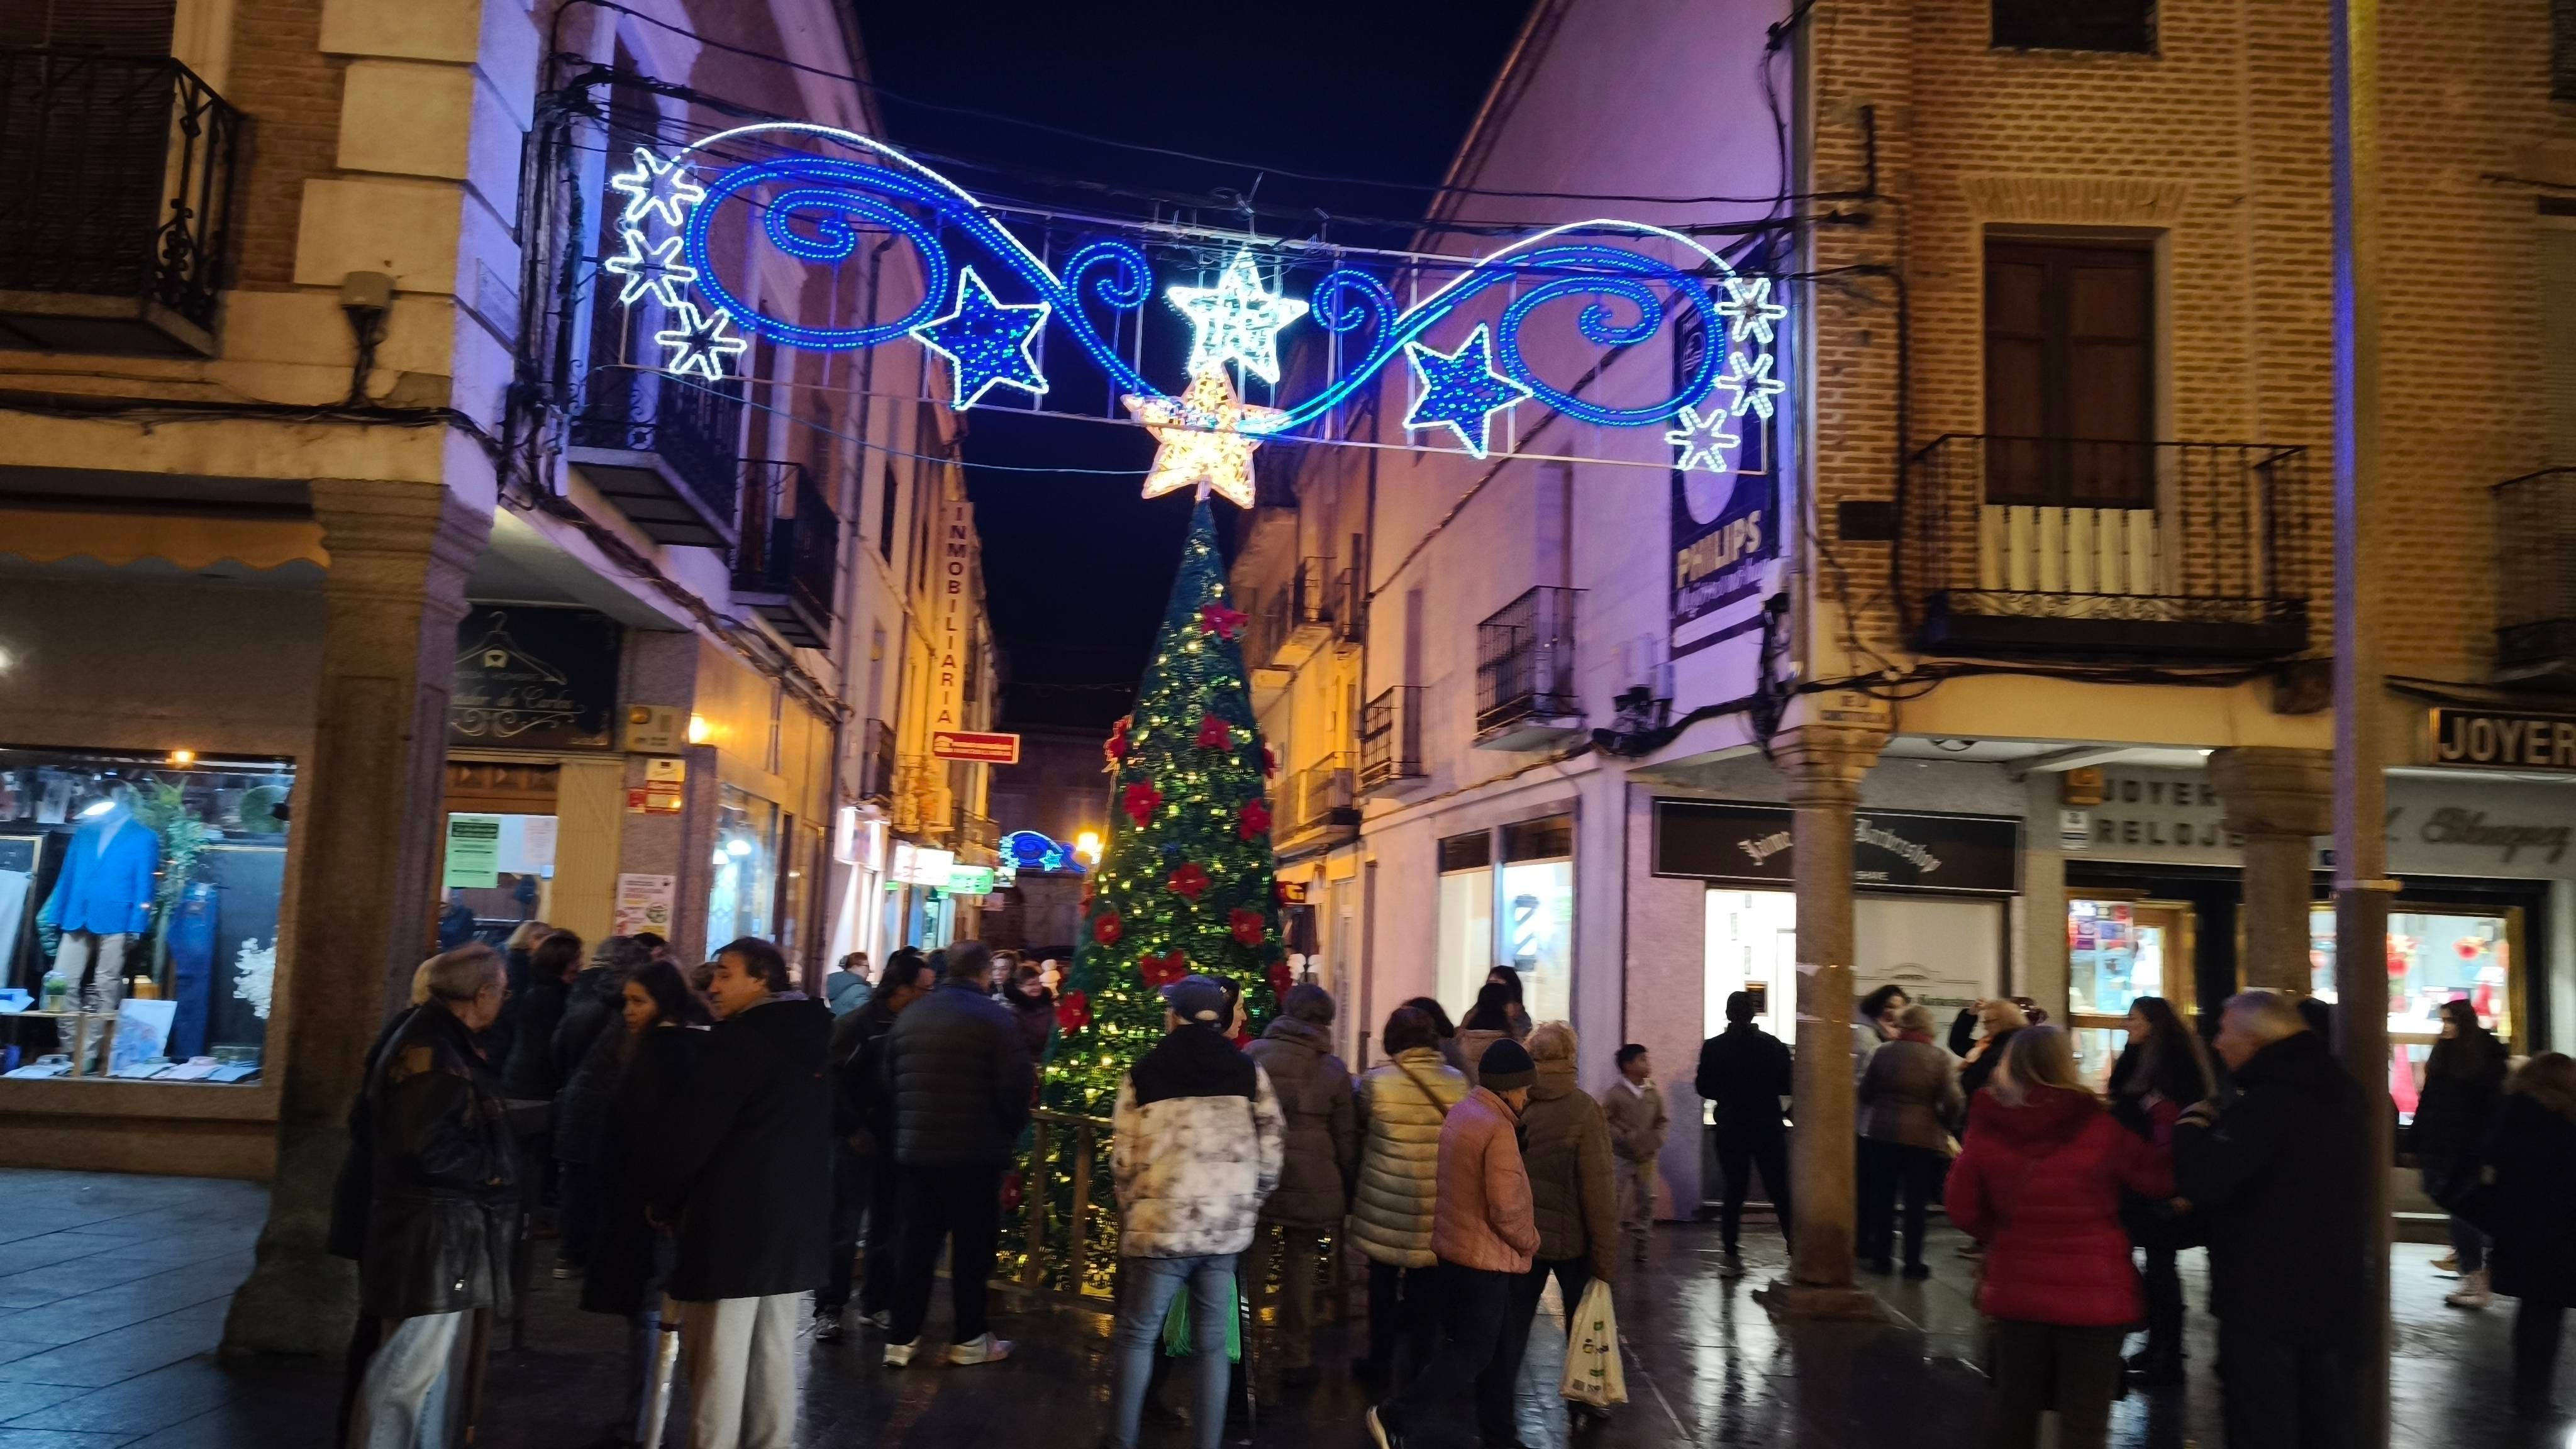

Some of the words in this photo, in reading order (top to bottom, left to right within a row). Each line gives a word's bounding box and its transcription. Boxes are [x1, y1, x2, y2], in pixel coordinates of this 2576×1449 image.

[1677, 510, 1762, 589] PHILIPS
[936, 506, 967, 724] INMOBILIARIA
[2441, 716, 2576, 766] JOYER
